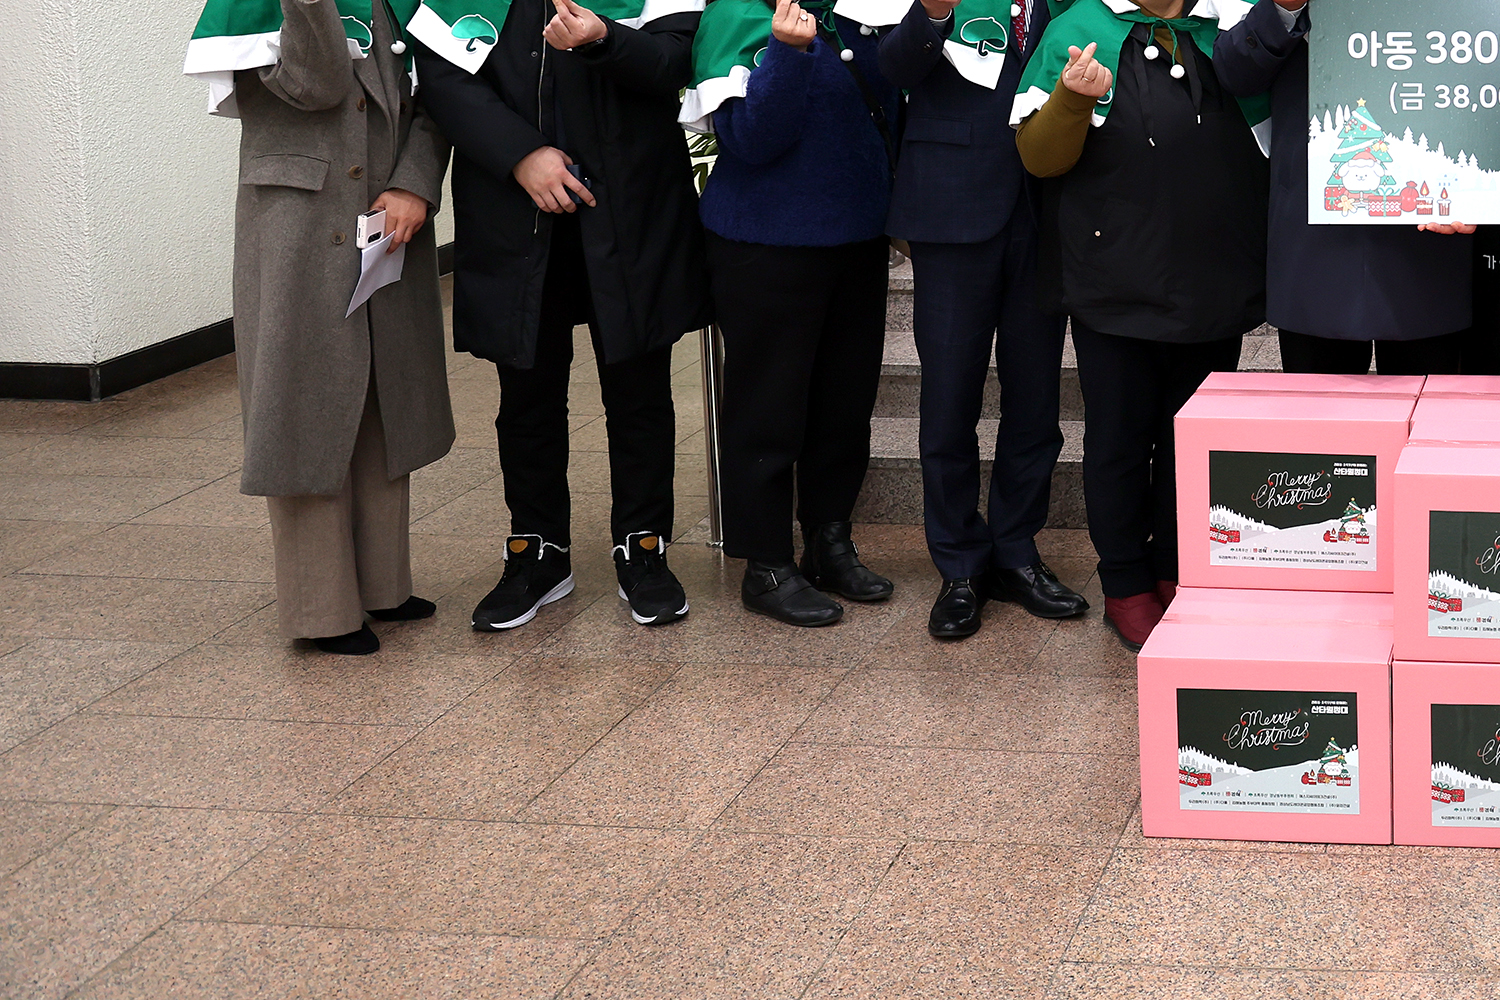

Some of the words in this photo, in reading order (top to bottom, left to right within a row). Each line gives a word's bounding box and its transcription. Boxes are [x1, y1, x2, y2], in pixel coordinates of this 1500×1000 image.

[1347, 29, 1418, 71] 아동
[1389, 81, 1426, 114] (금
[1267, 469, 1324, 488] Merry
[1251, 482, 1332, 510] Christmas
[1240, 707, 1301, 728] Merry
[1223, 721, 1310, 750] Christmas
